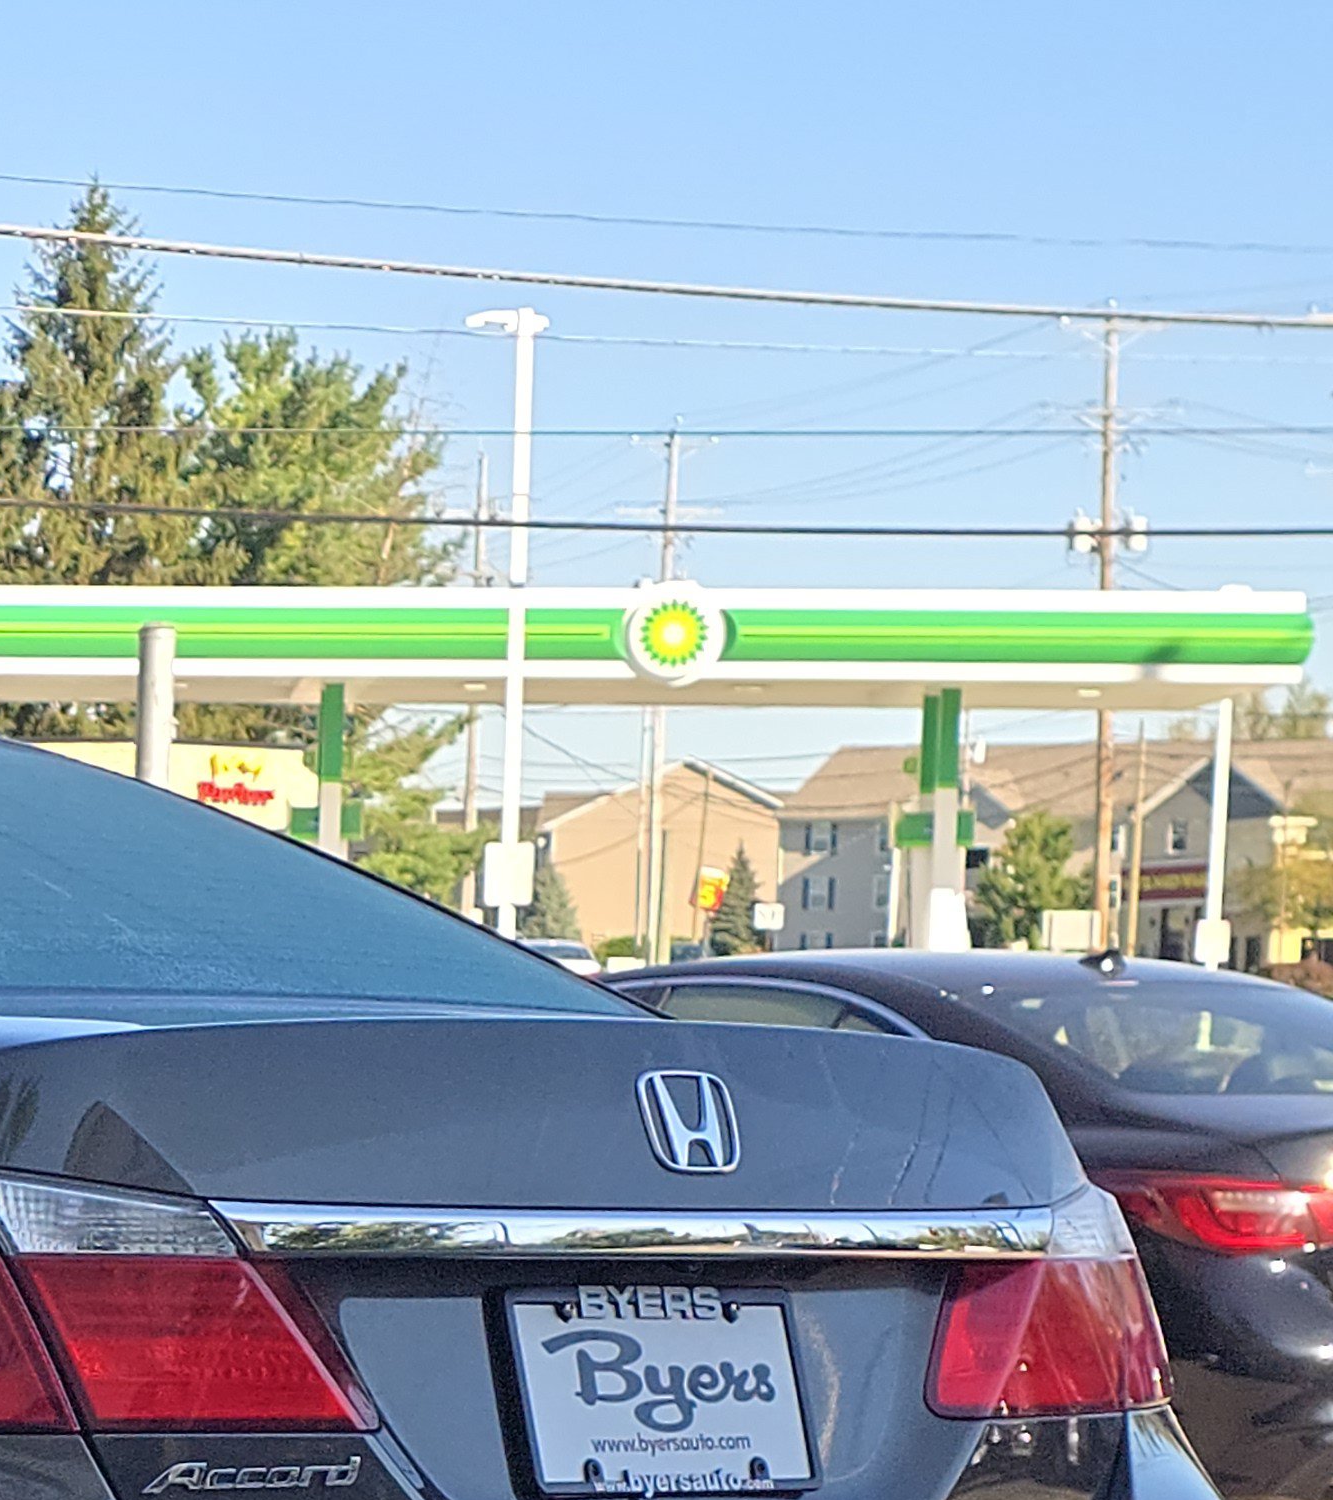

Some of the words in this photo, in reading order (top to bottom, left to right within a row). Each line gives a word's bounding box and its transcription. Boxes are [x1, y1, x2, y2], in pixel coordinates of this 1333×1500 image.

[578, 1285, 721, 1319] BYERS
[541, 1328, 776, 1432] Byers
[590, 1432, 751, 1457] www.byersauto.com
[141, 1455, 361, 1494] Accord
